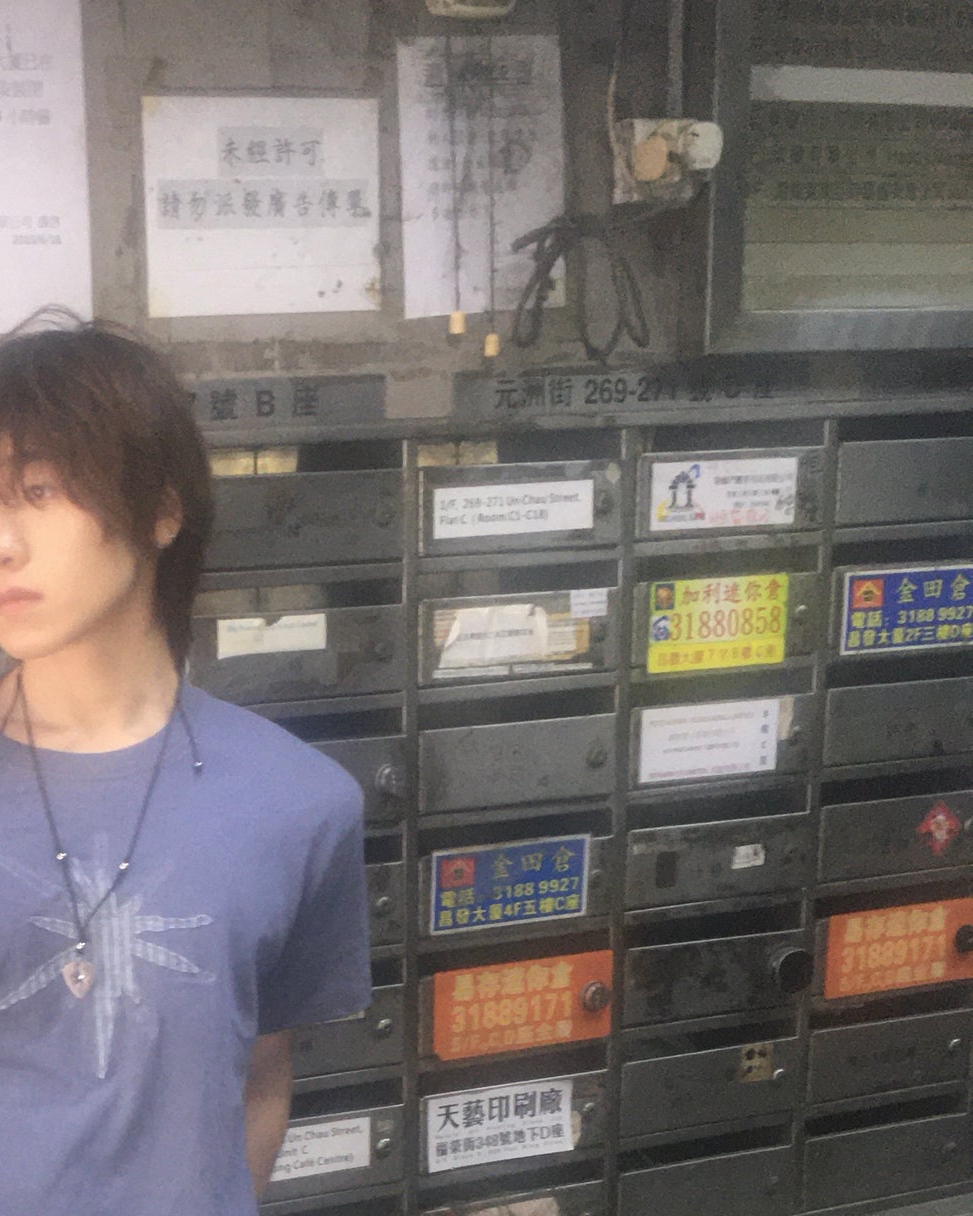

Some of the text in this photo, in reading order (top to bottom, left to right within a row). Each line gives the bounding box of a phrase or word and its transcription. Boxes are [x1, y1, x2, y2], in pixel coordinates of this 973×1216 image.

[220, 136, 322, 168] 未經許可
[254, 389, 277, 418] B
[494, 377, 573, 409] 元洲街
[670, 604, 783, 641] 31880858
[538, 876, 581, 895] 9927
[436, 1087, 564, 1133] 天藝印刷廠
